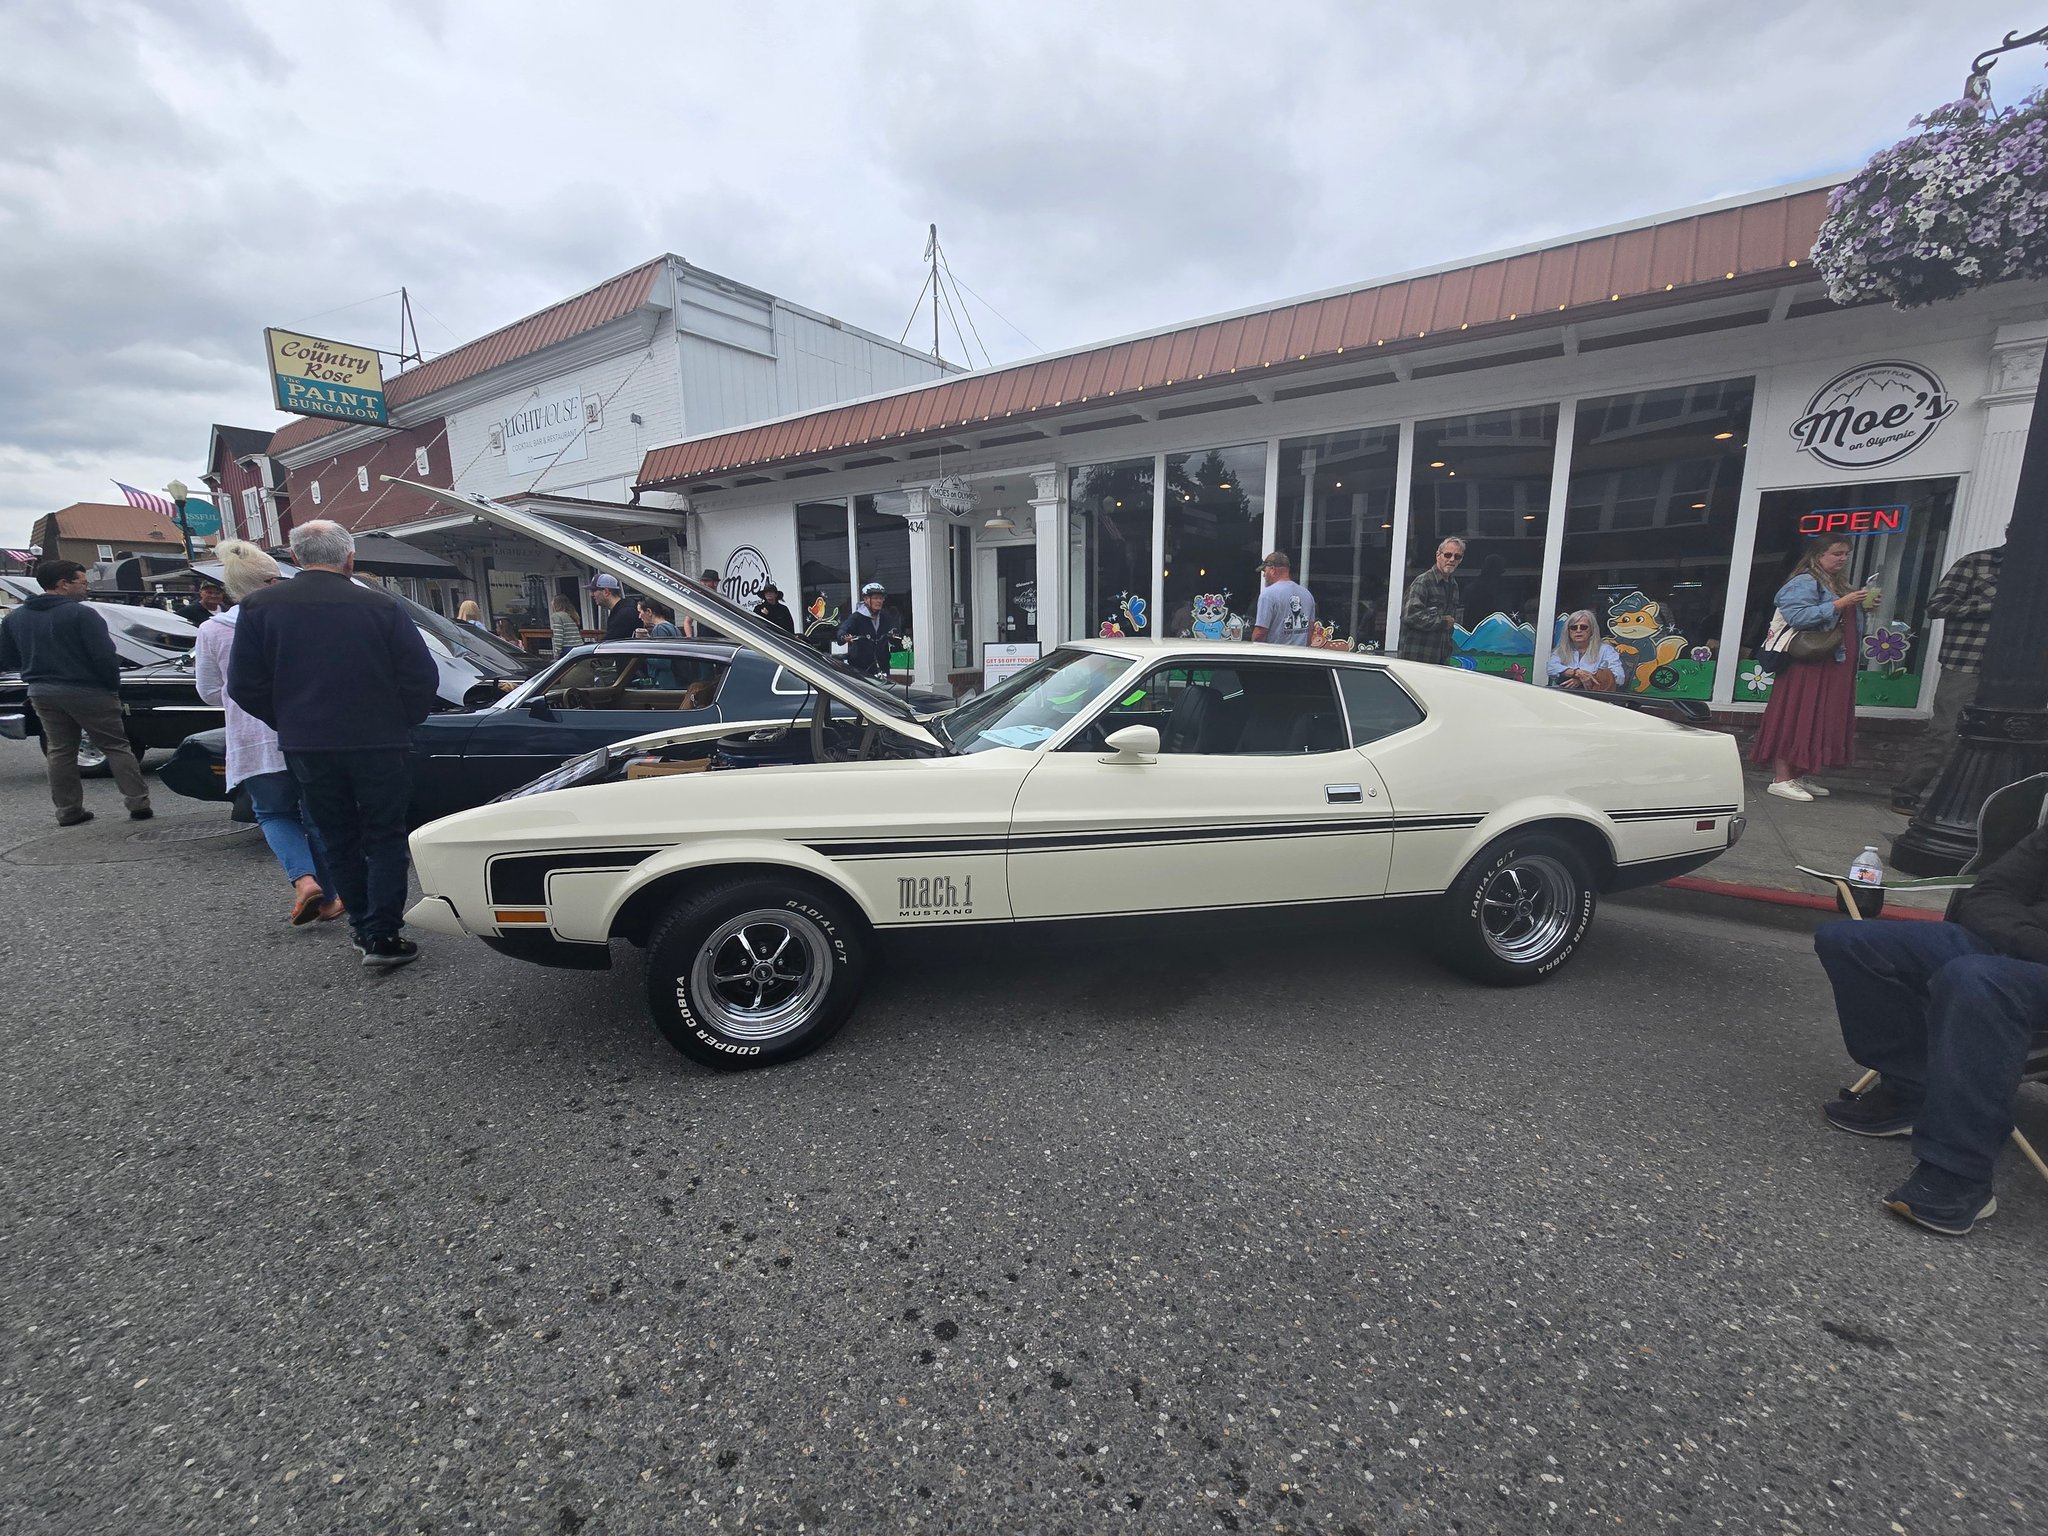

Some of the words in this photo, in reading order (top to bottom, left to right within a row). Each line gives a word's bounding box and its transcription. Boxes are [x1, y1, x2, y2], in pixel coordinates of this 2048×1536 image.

[281, 341, 371, 375] Country
[313, 342, 330, 351] the
[304, 362, 353, 383] Rose
[1891, 370, 1912, 379] PLACE
[287, 383, 379, 409] PAINT
[287, 398, 379, 420] BUNGALOW
[505, 396, 578, 438] LIGHTHOUSE
[1794, 392, 1953, 447] Moe's
[512, 441, 533, 452] COCKTAIL
[533, 438, 542, 447] BAR
[547, 429, 577, 442] RESTAURANT
[1849, 443, 1865, 451] on
[1866, 429, 1916, 448] Olympic
[908, 521, 924, 533] 434
[1799, 509, 1900, 534] OPEN
[619, 554, 640, 568] 351
[642, 567, 669, 583] RAM
[671, 582, 691, 595] AIR
[897, 875, 959, 909] mach
[963, 874, 973, 906] 1
[1471, 869, 1495, 918] RADIAL
[1496, 849, 1515, 868] G/T
[899, 908, 973, 917] MUSTANG
[1573, 890, 1591, 943] COOPER
[785, 900, 836, 936] RADIAL
[834, 939, 848, 964] G/T
[1538, 944, 1573, 974] COBRA
[676, 975, 697, 1027] COBRA
[696, 1029, 760, 1056] COOPER
